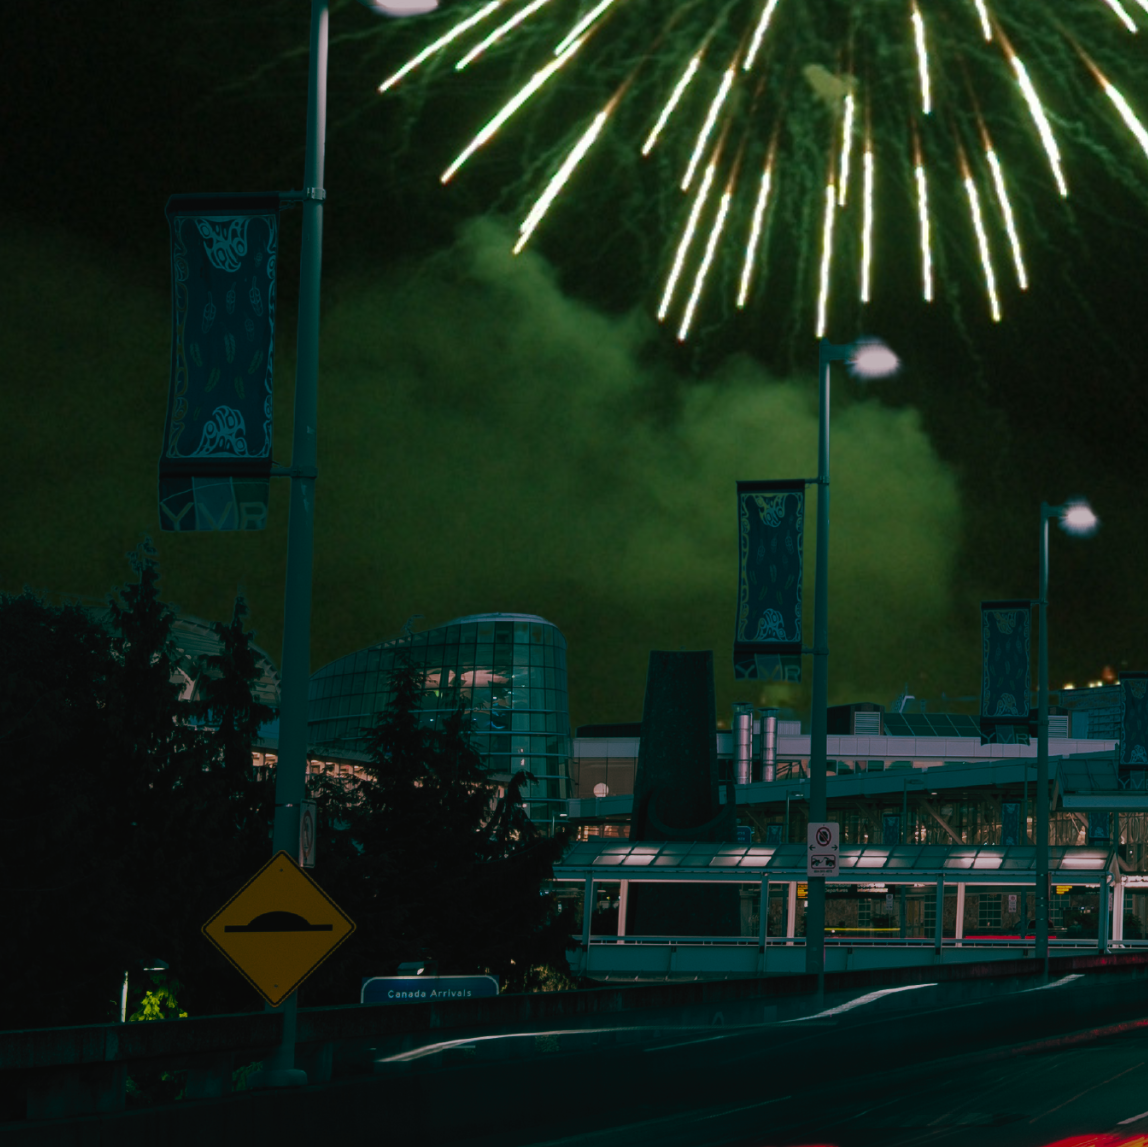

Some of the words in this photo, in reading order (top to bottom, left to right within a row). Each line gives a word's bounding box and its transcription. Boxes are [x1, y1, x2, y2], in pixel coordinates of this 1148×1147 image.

[160, 501, 268, 531] YVR
[387, 989, 427, 999] Canada
[430, 988, 472, 998] Arrivals
